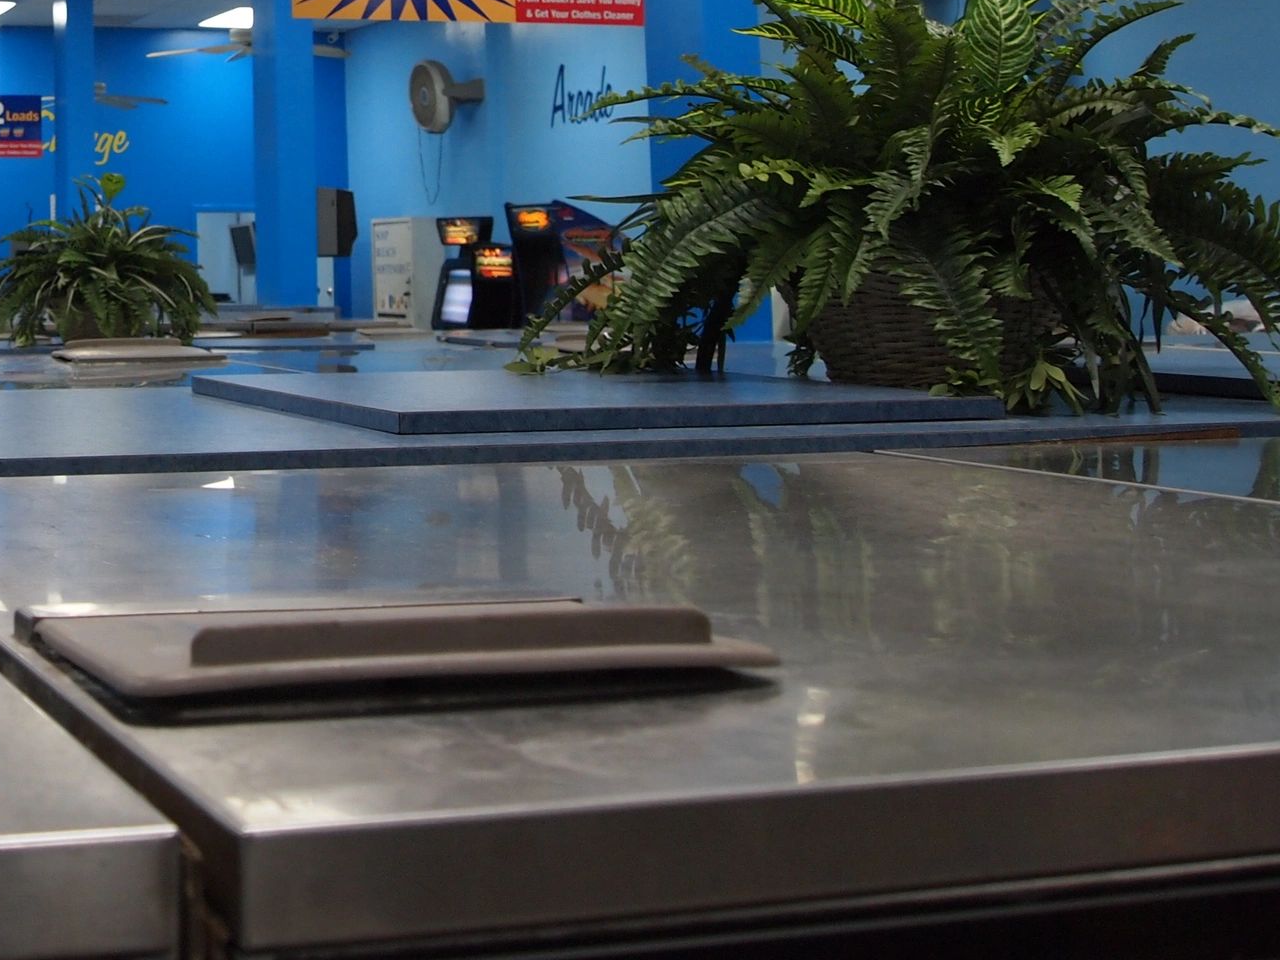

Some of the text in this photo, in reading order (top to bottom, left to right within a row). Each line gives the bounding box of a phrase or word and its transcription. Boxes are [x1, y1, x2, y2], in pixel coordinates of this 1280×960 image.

[534, 9, 549, 18] Get
[551, 10, 569, 19] Your
[6, 110, 40, 122] Loads
